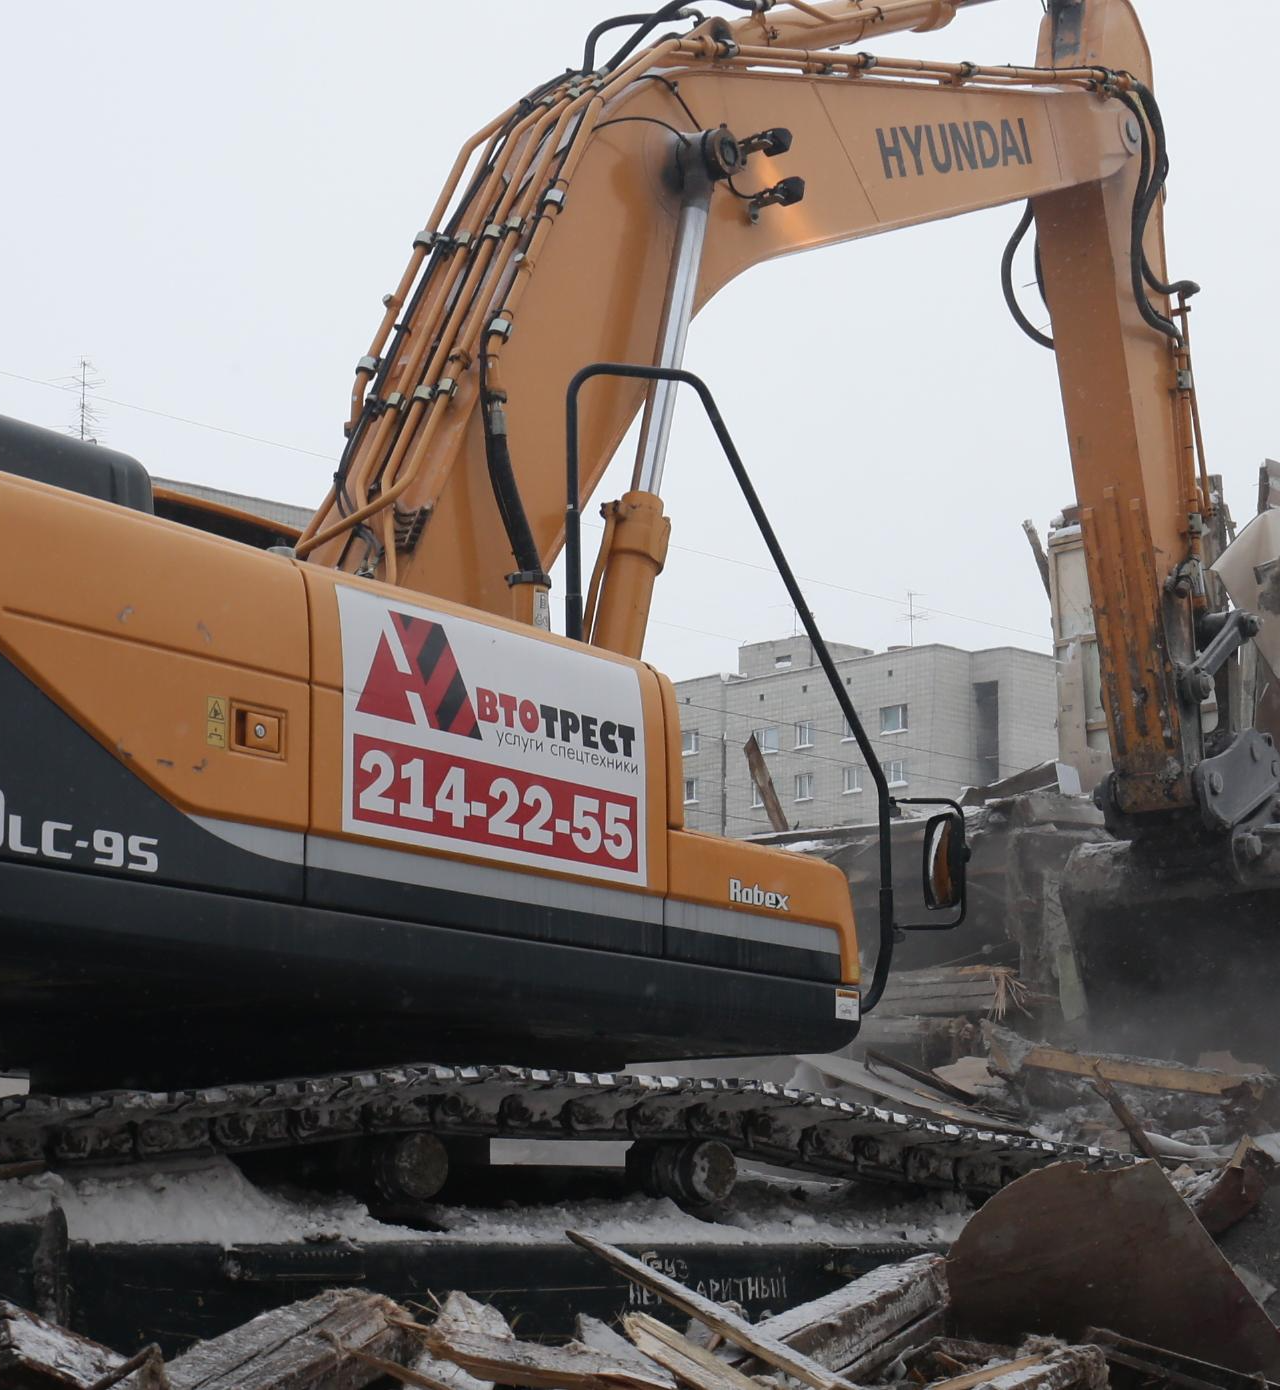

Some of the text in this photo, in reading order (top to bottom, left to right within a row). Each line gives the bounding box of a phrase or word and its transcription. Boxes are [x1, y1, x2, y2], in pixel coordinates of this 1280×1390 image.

[875, 117, 1032, 179] HYUNDAI
[495, 728, 639, 775] услуги спецтехники
[359, 749, 633, 861] 214-22-55
[629, 1265, 788, 1305] НЕАРИТНЫЙ
